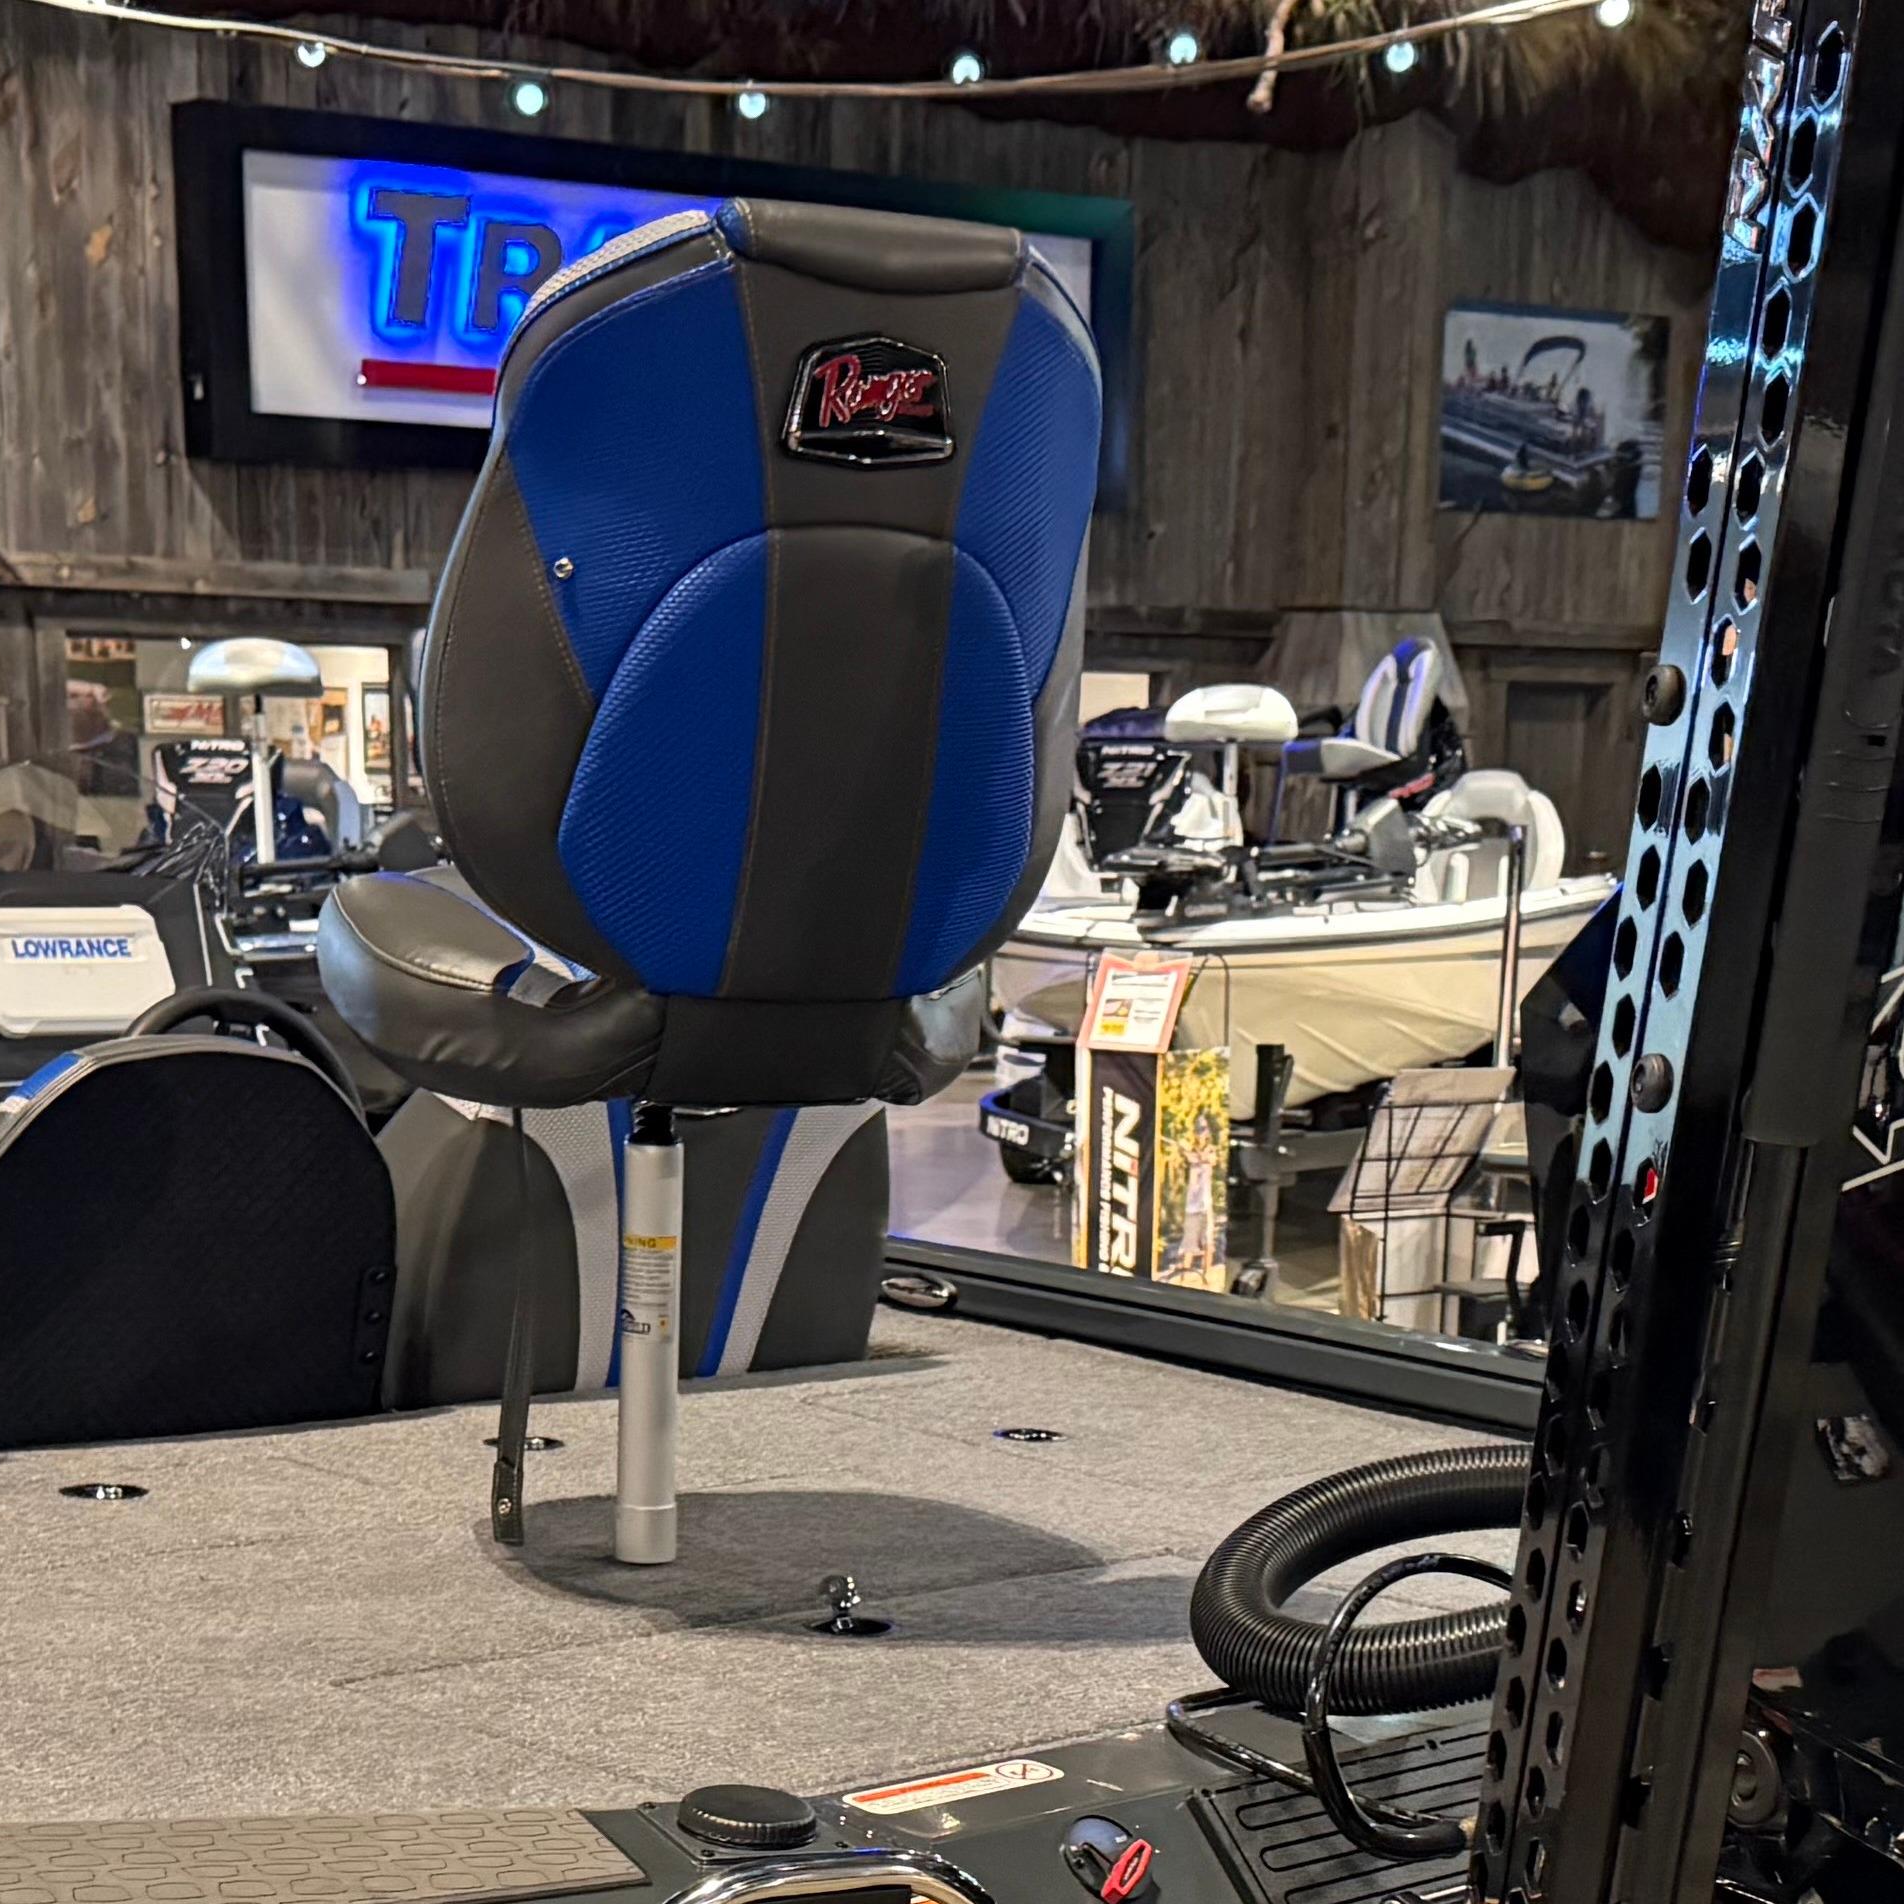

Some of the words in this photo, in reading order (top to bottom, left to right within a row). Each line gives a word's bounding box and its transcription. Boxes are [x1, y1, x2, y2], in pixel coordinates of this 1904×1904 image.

[368, 187, 563, 333] TR
[12, 939, 132, 958] LOWRANCE
[987, 1117, 1030, 1146] NITRO
[1110, 1093, 1141, 1277] NITR
